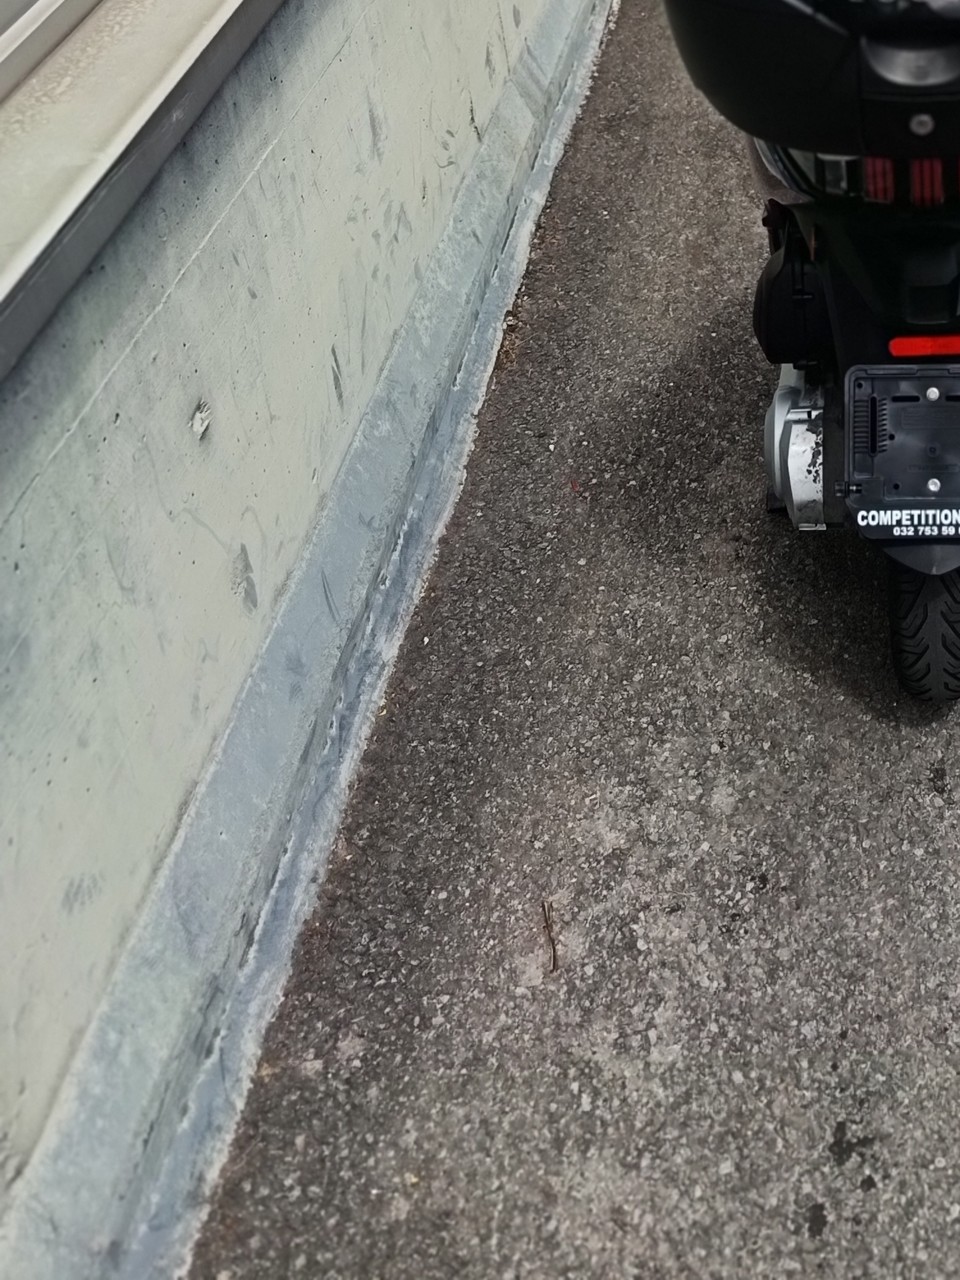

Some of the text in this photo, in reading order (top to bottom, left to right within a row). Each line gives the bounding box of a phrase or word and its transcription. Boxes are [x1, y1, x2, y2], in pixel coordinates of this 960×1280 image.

[893, 526, 914, 536] 032
[917, 526, 938, 536] 753
[941, 526, 956, 535] 59
